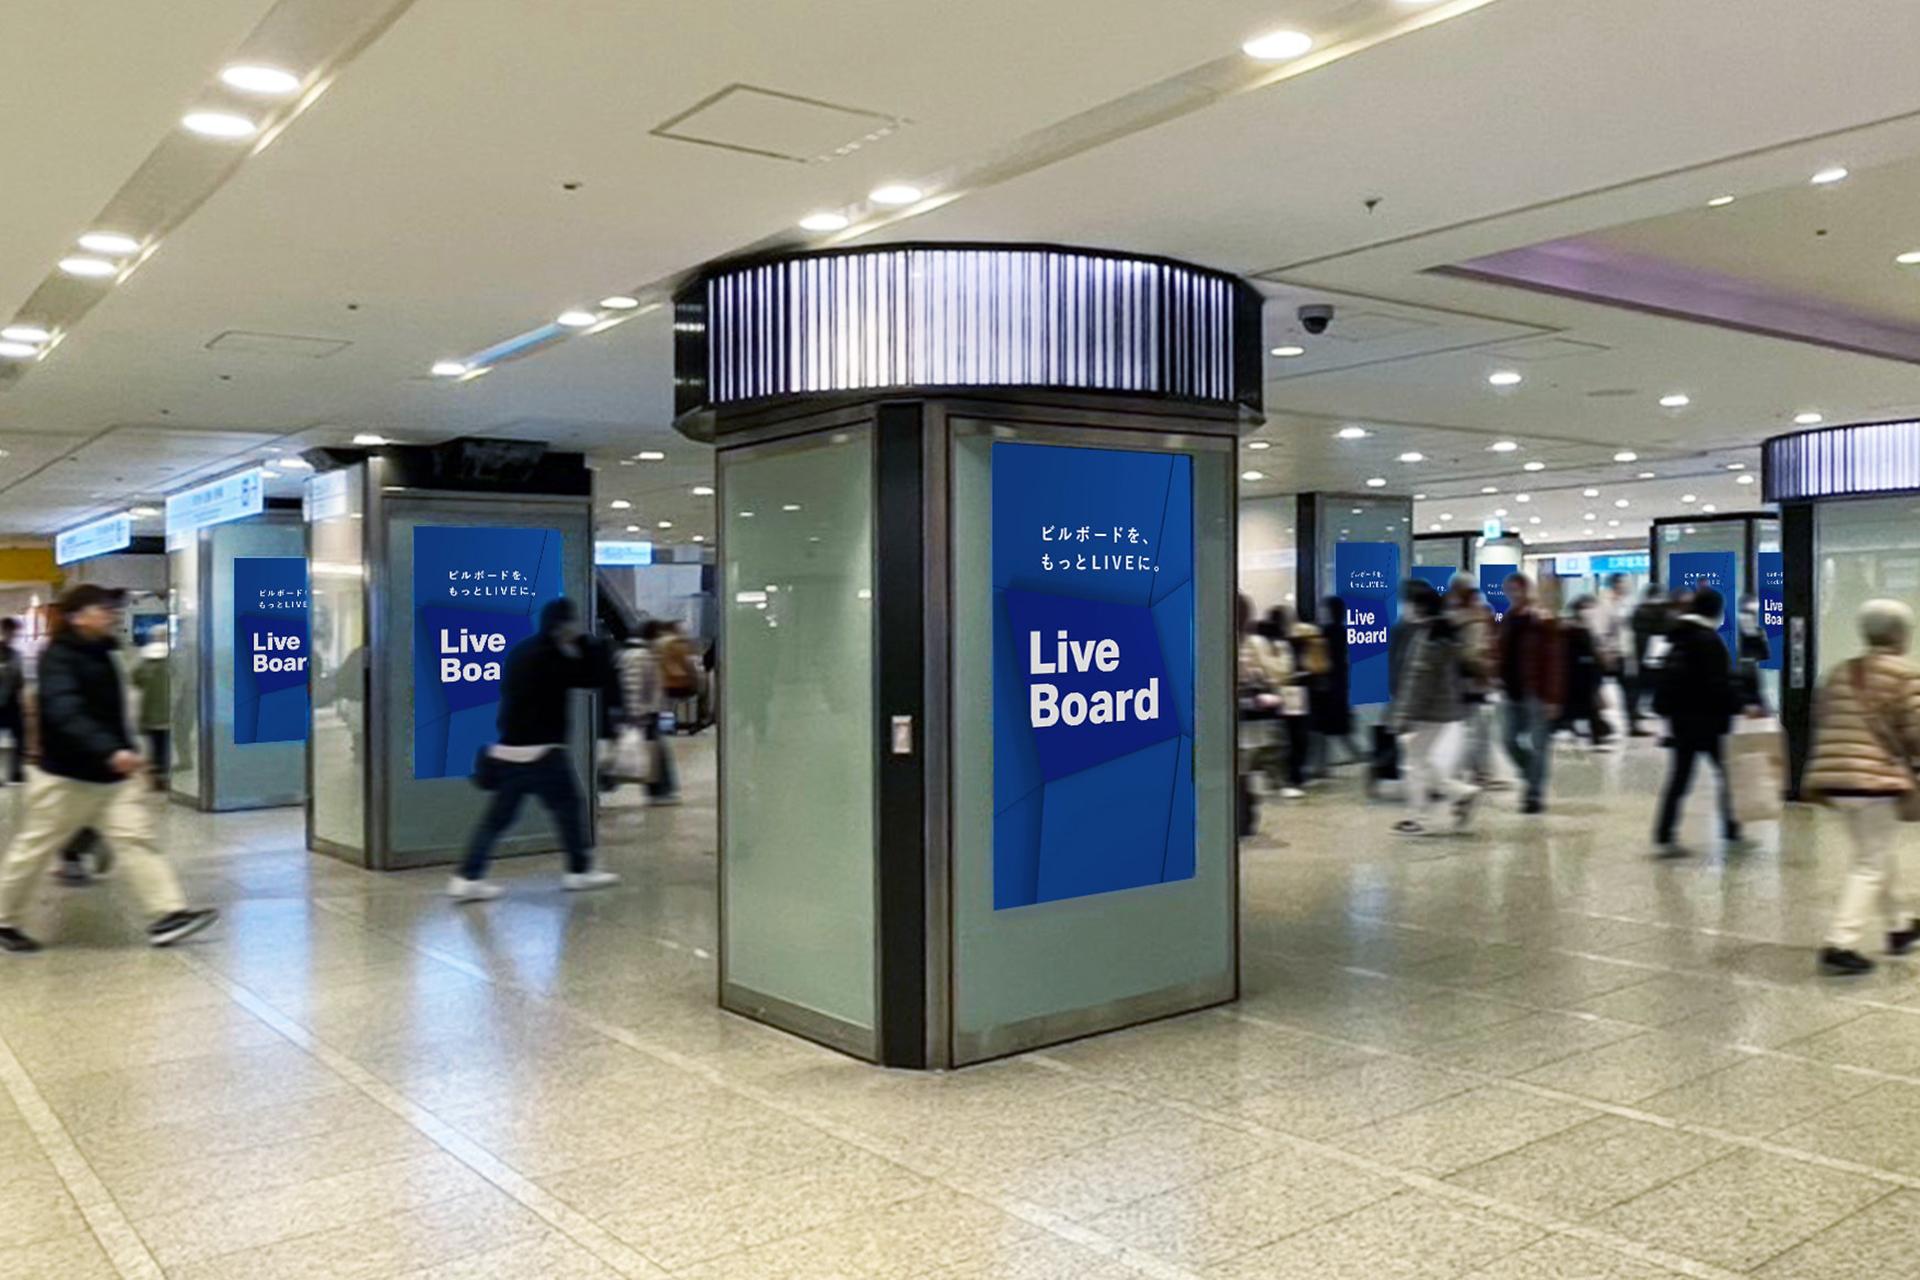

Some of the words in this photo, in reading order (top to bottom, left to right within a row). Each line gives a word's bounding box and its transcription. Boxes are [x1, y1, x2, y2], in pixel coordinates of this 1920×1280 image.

[1041, 525, 1149, 545] ビルボードを、
[1041, 553, 1160, 573] もっとLIVEに。
[259, 589, 308, 598] ビルボード
[1764, 599, 1783, 612] Live
[1346, 608, 1375, 626] Live
[1764, 613, 1783, 625] Boa
[253, 632, 301, 651] Live
[441, 628, 507, 654] Live
[1346, 626, 1387, 645] Board
[1030, 630, 1120, 675] Live
[253, 653, 308, 673] Boar
[441, 657, 501, 683] Boa
[1030, 677, 1159, 728] Board
